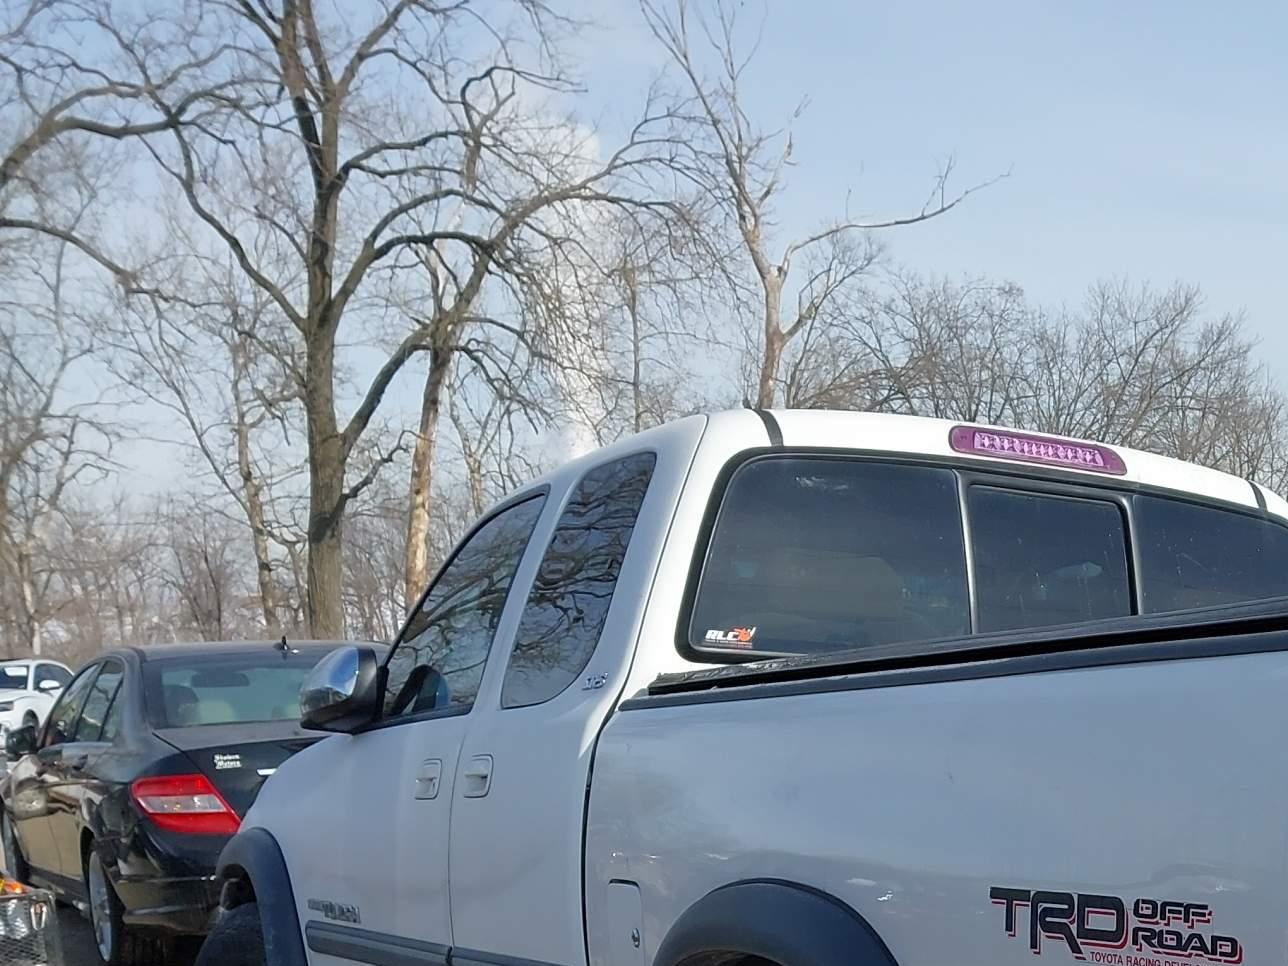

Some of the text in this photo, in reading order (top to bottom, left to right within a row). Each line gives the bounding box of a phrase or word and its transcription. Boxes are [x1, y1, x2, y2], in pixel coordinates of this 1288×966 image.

[704, 629, 739, 641] RLC
[989, 886, 1129, 960] TRD
[1132, 898, 1212, 929] OFF
[1089, 951, 1124, 966] TOYOTA
[1131, 926, 1243, 965] ROAD
